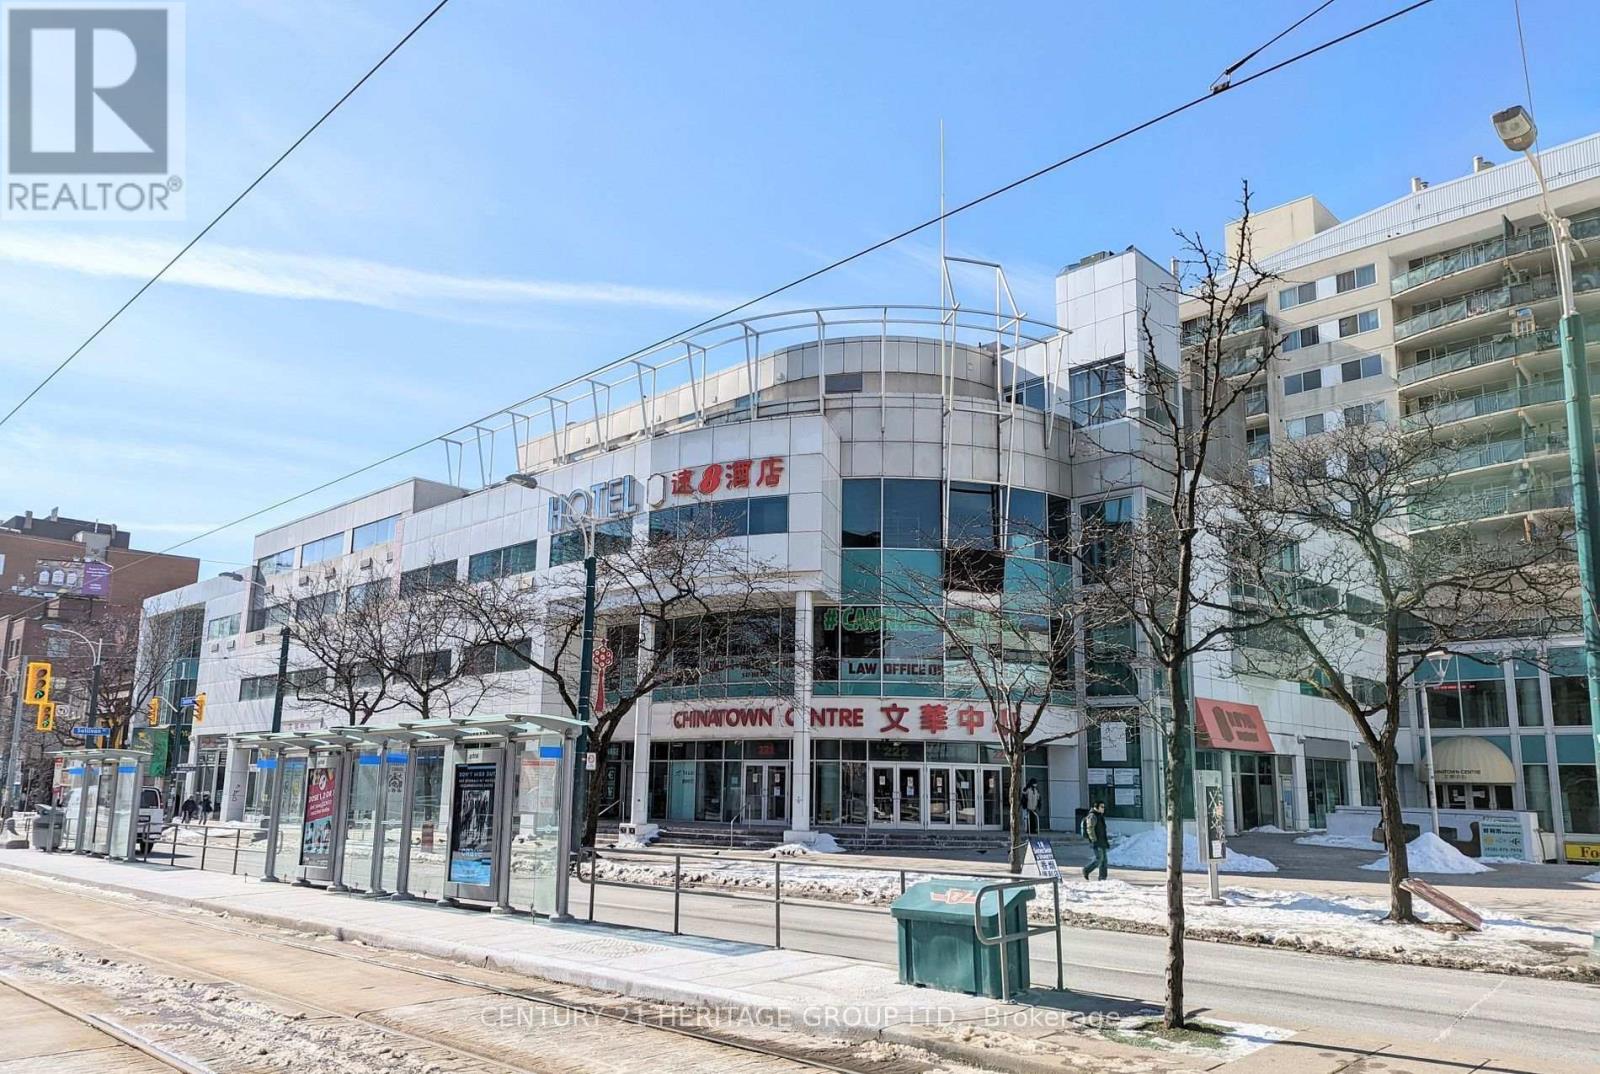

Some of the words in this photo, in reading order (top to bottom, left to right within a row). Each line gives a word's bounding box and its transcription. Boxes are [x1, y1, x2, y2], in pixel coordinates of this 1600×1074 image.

[671, 456, 785, 494] 速8酒店
[548, 474, 638, 532] HOTEL
[848, 662, 877, 675] LAW
[883, 663, 926, 676] OFFICE
[673, 706, 774, 729] CHINATOWN
[784, 707, 865, 728] CNTRE
[1581, 846, 1600, 859] Fo
